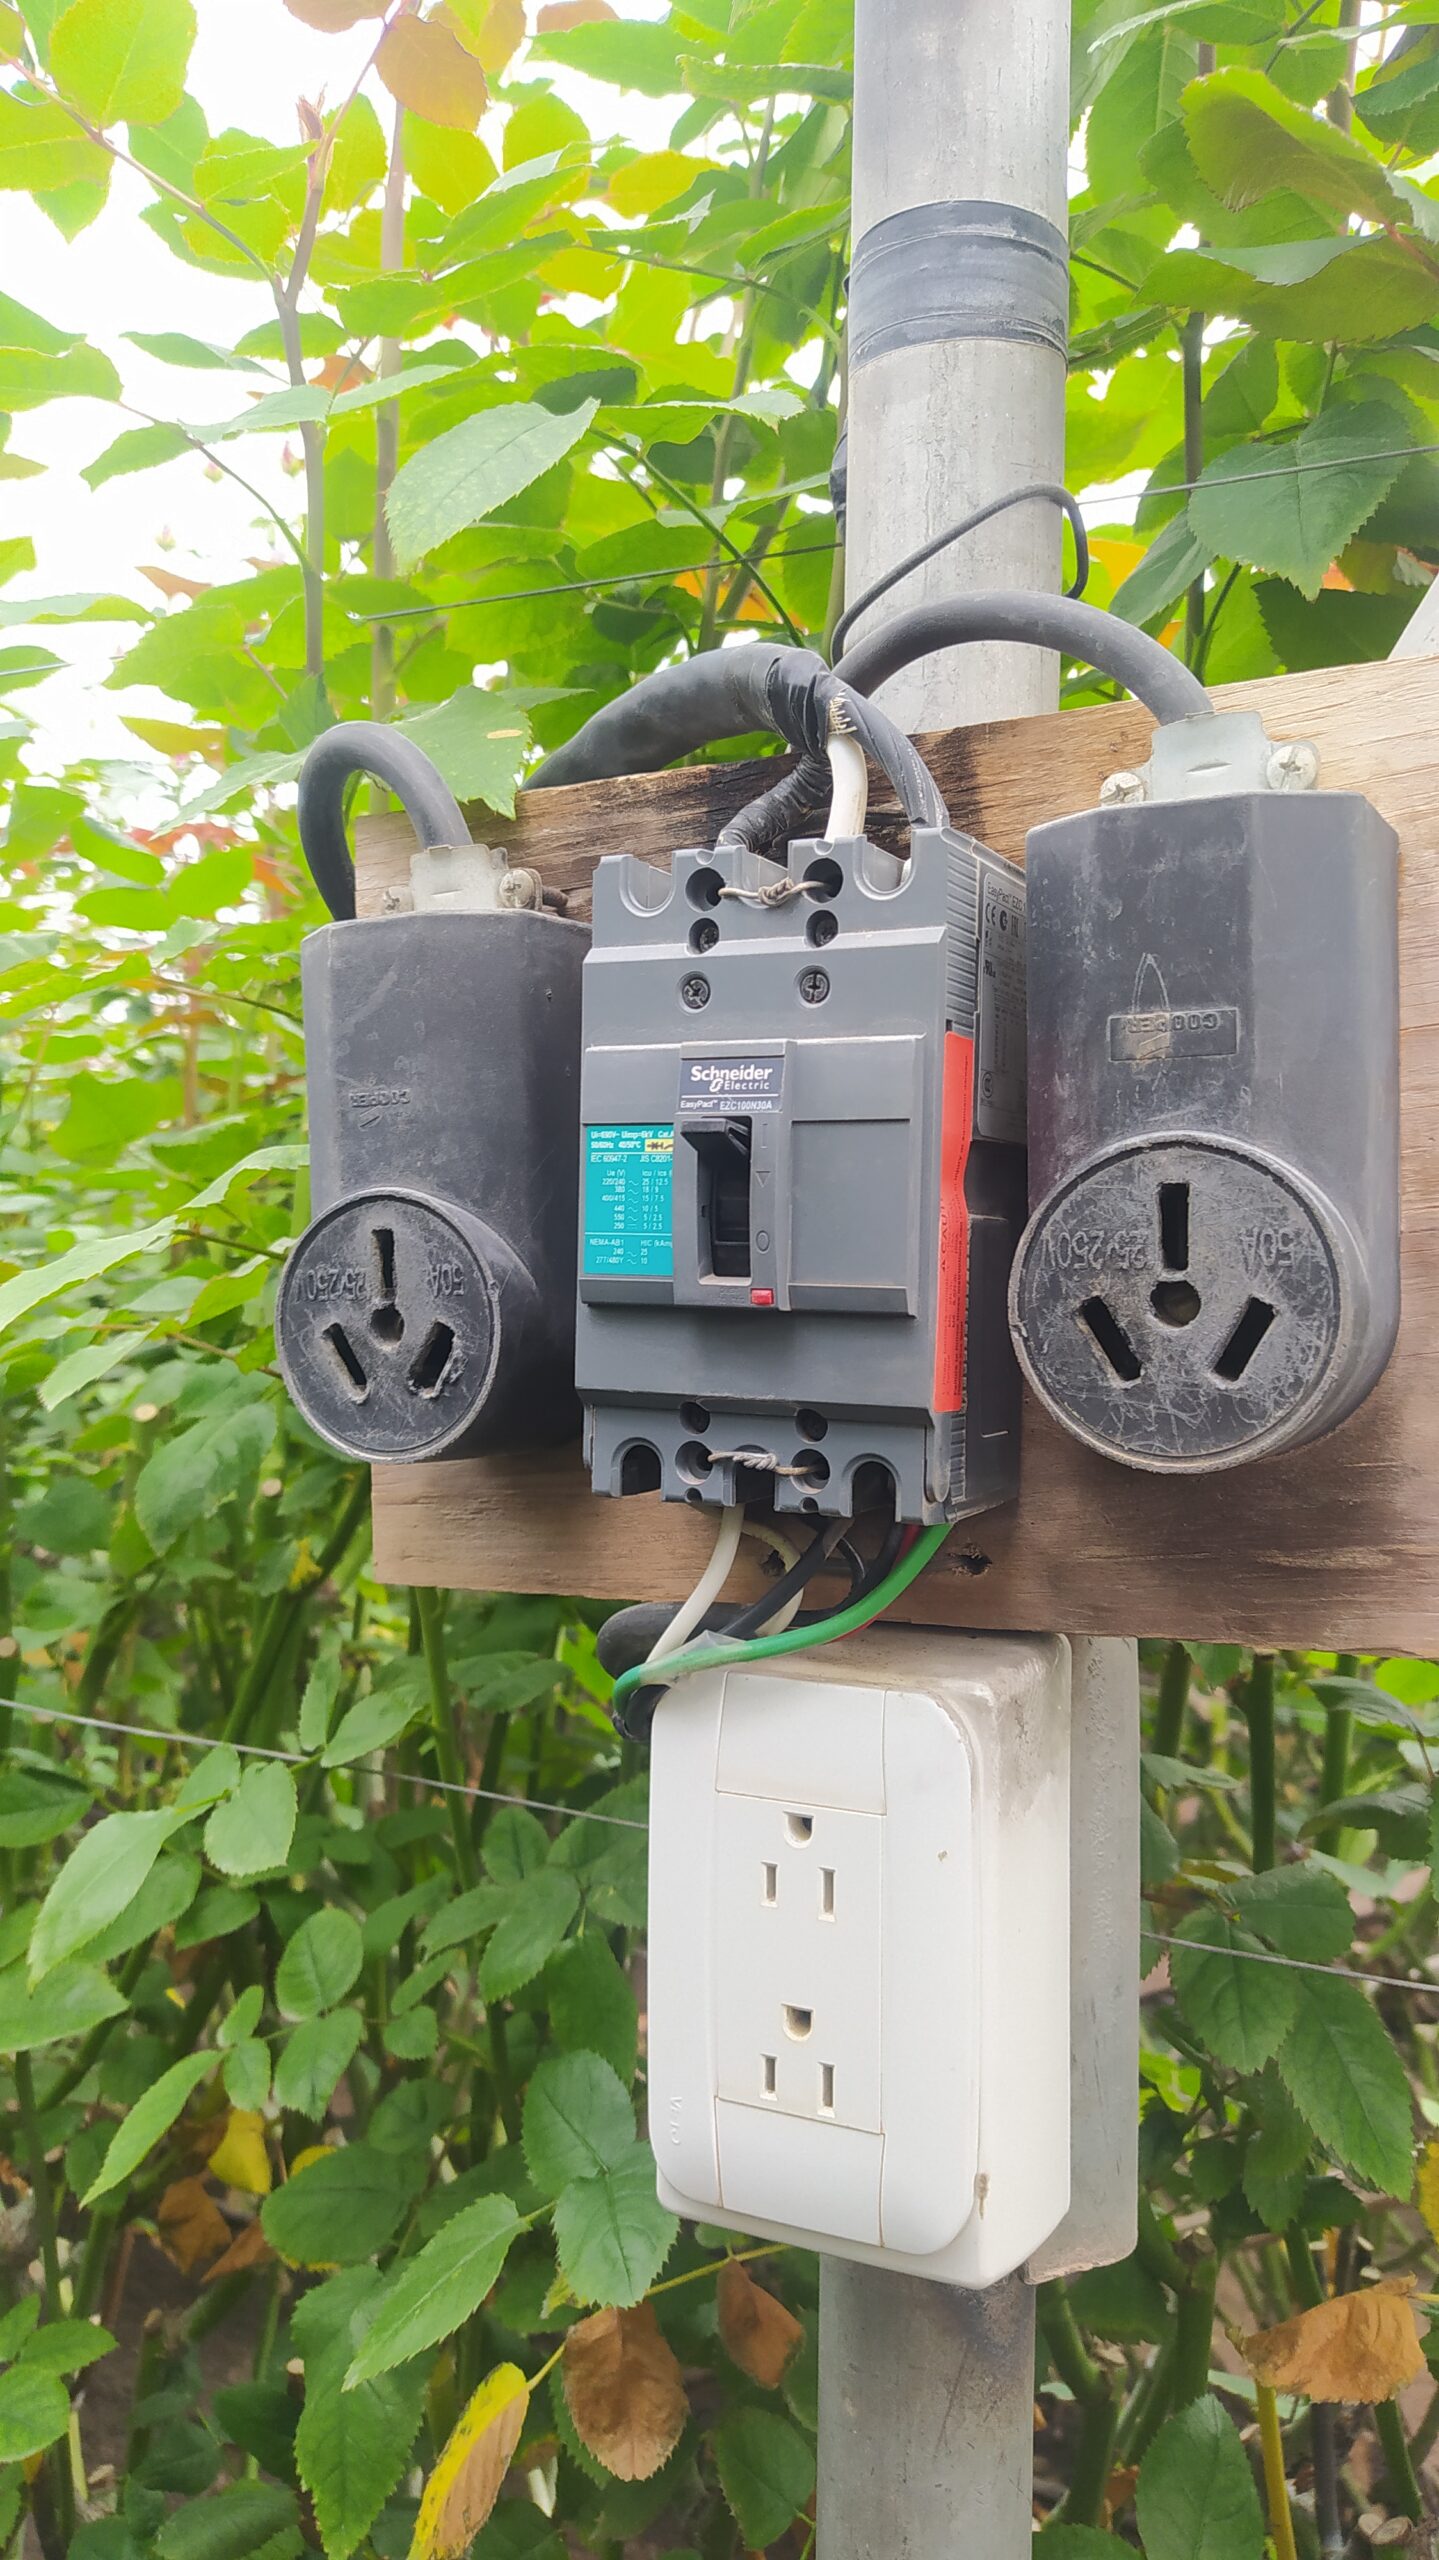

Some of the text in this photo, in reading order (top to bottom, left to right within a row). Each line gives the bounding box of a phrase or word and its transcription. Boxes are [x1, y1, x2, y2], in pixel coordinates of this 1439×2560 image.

[690, 1064, 773, 1081] Schneider
[723, 1081, 770, 1091] Electric
[590, 1154, 628, 1163] IEC 60947-2
[602, 1177, 626, 1186] 220/240
[601, 1194, 626, 1202] 400/415
[613, 1204, 625, 1212] 440
[613, 1222, 625, 1230] 250
[589, 1238, 624, 1246] NEMA-AB1
[612, 1247, 648, 1256] 240 25
